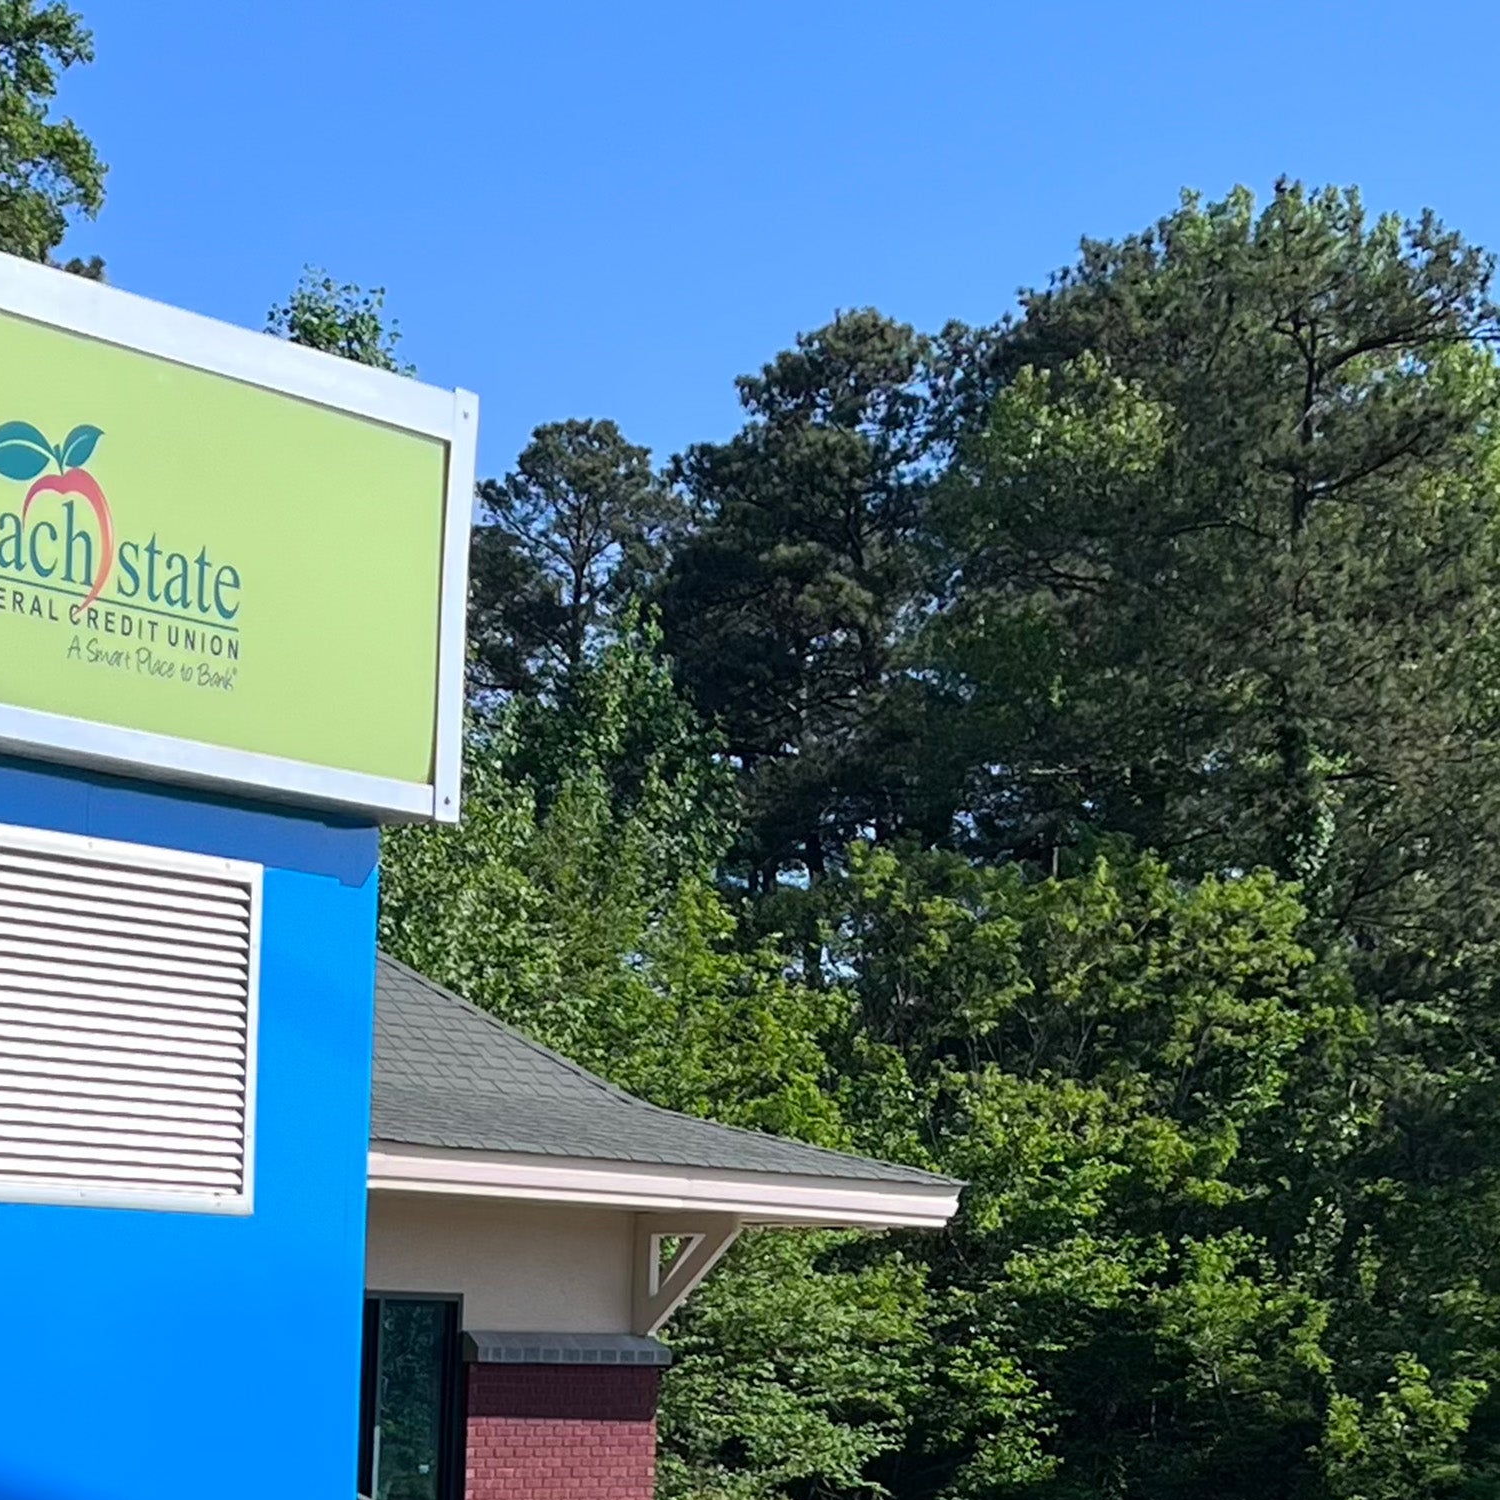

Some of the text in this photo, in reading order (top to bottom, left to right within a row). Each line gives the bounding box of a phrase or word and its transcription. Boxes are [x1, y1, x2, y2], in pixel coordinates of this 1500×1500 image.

[116, 532, 241, 620] state
[67, 635, 81, 660] A
[86, 638, 131, 669] Smart
[136, 647, 175, 679] Place
[180, 663, 193, 682] to
[69, 604, 159, 642] CREDIT
[168, 625, 239, 660] UNION
